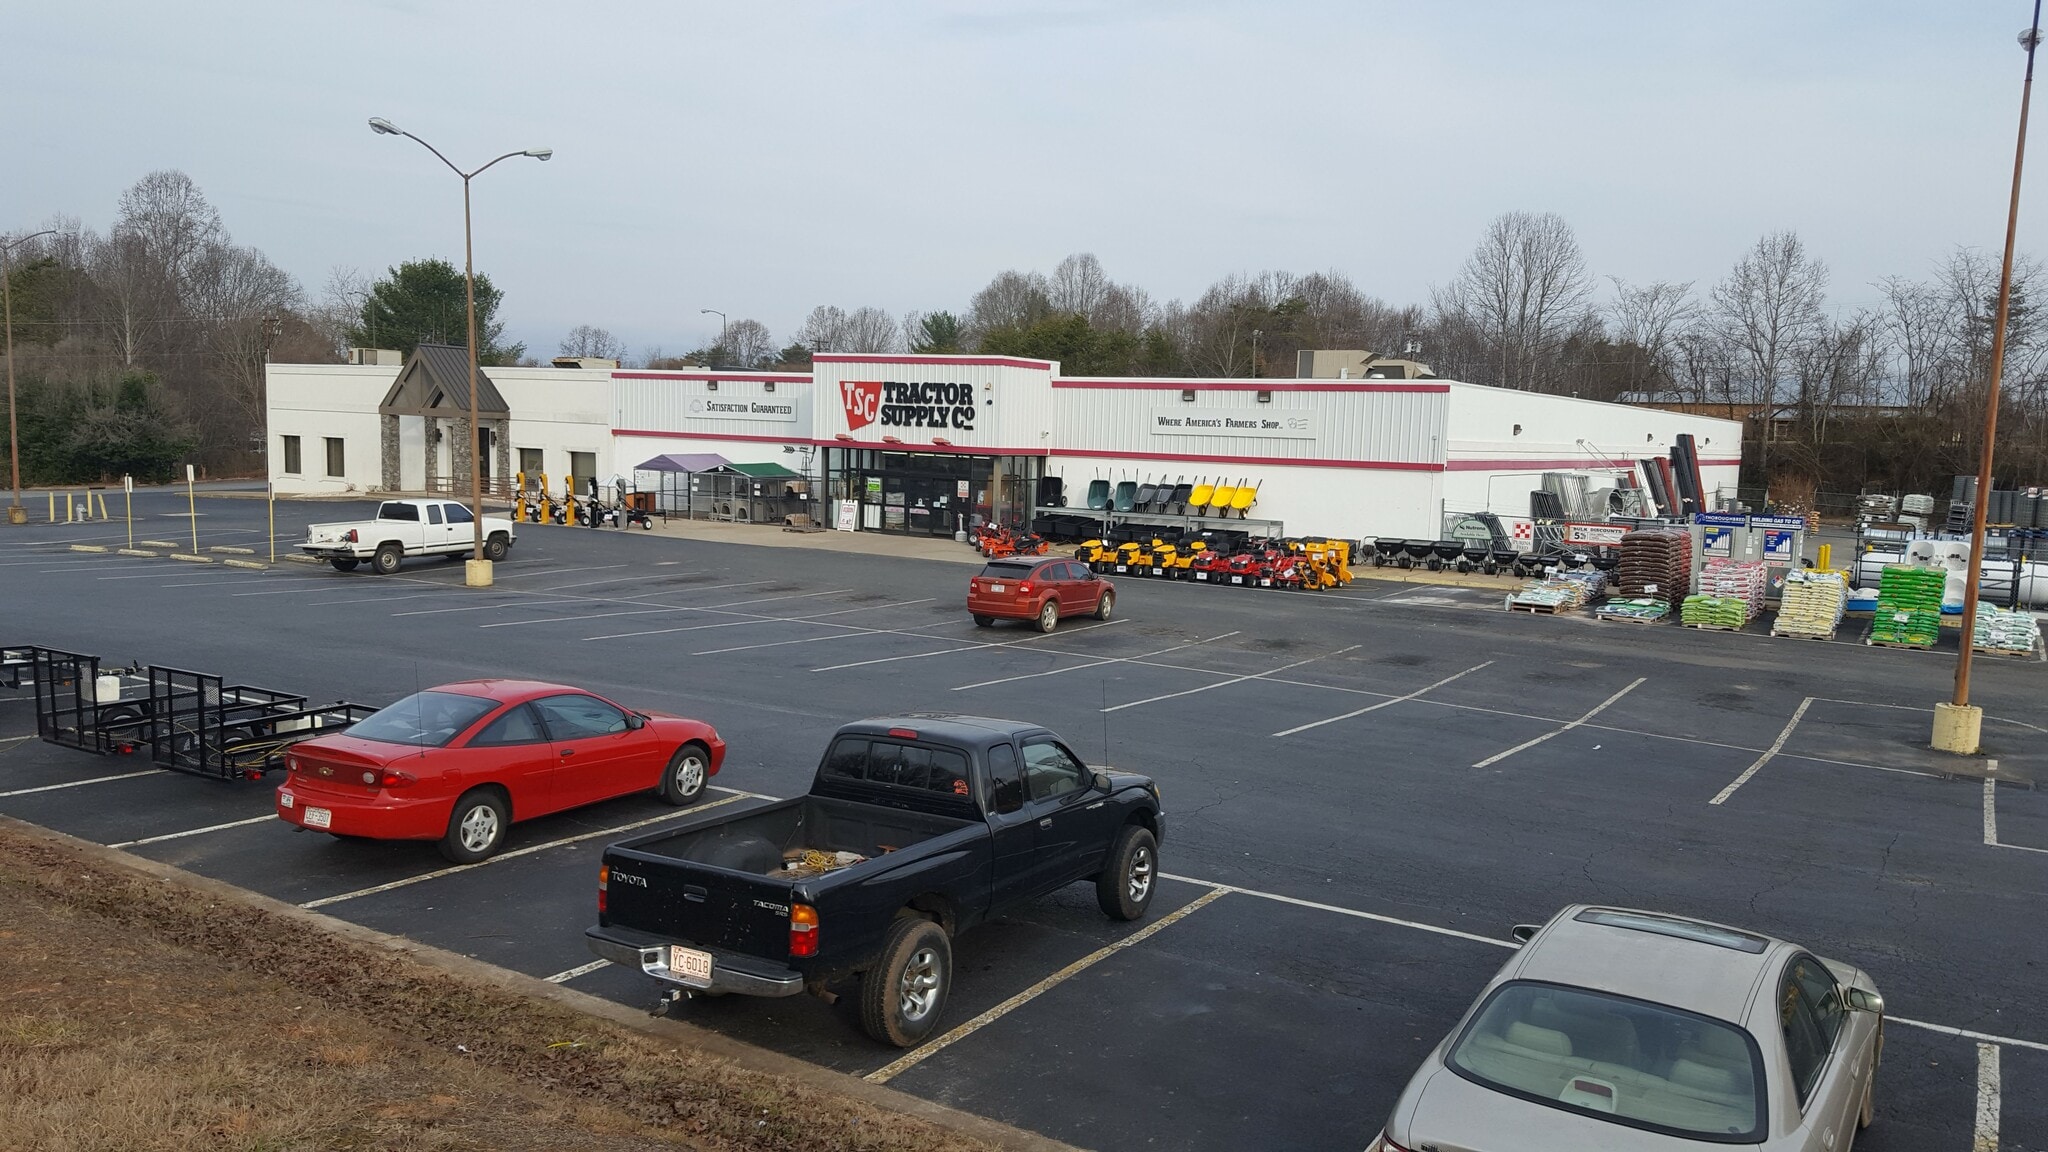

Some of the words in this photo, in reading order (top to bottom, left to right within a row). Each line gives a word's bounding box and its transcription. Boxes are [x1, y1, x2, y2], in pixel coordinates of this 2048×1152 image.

[844, 382, 875, 422] TSC
[883, 382, 973, 406] TRACTOR
[880, 405, 950, 427] SUPPLY
[611, 871, 647, 888] TOYOTA
[752, 900, 788, 912] TACOMA
[673, 953, 709, 974] YC-6018
